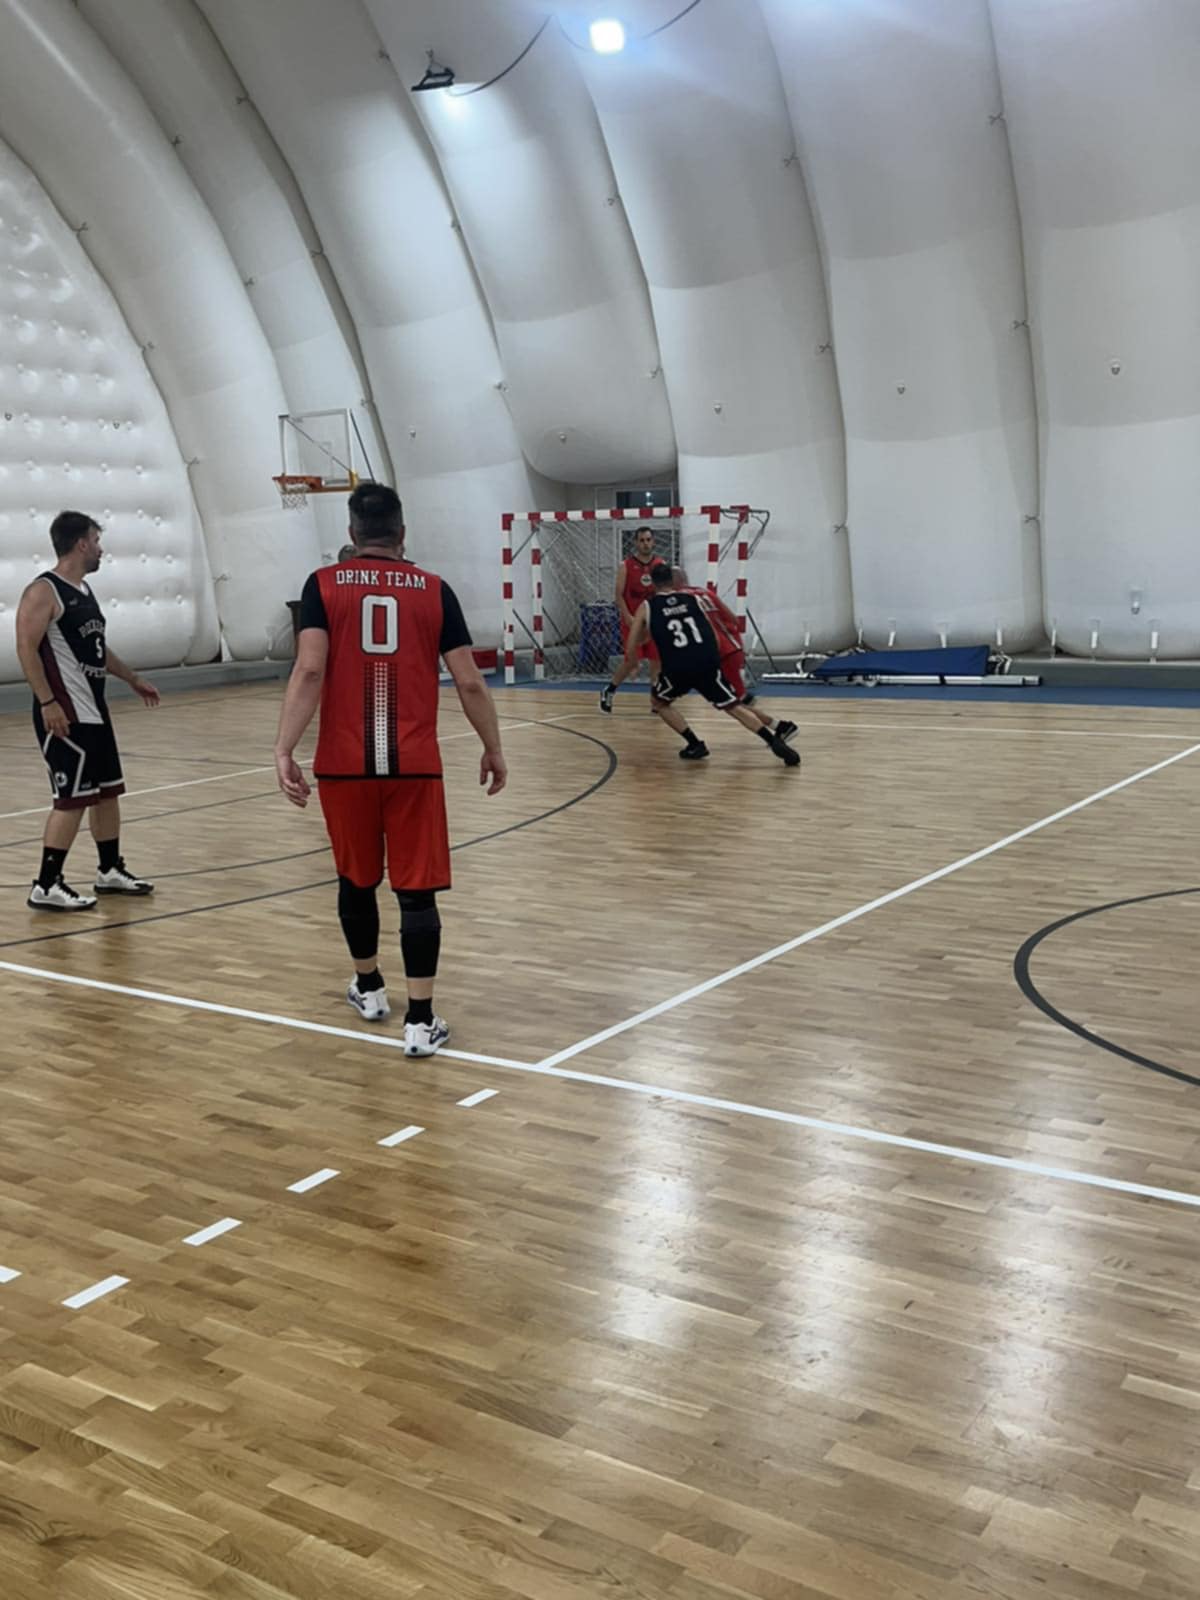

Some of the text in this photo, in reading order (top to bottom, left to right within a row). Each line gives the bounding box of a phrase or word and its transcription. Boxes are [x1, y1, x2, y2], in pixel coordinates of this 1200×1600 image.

[336, 569, 427, 590] DRINK TEAM
[361, 594, 399, 654] 0
[667, 616, 703, 648] 31
